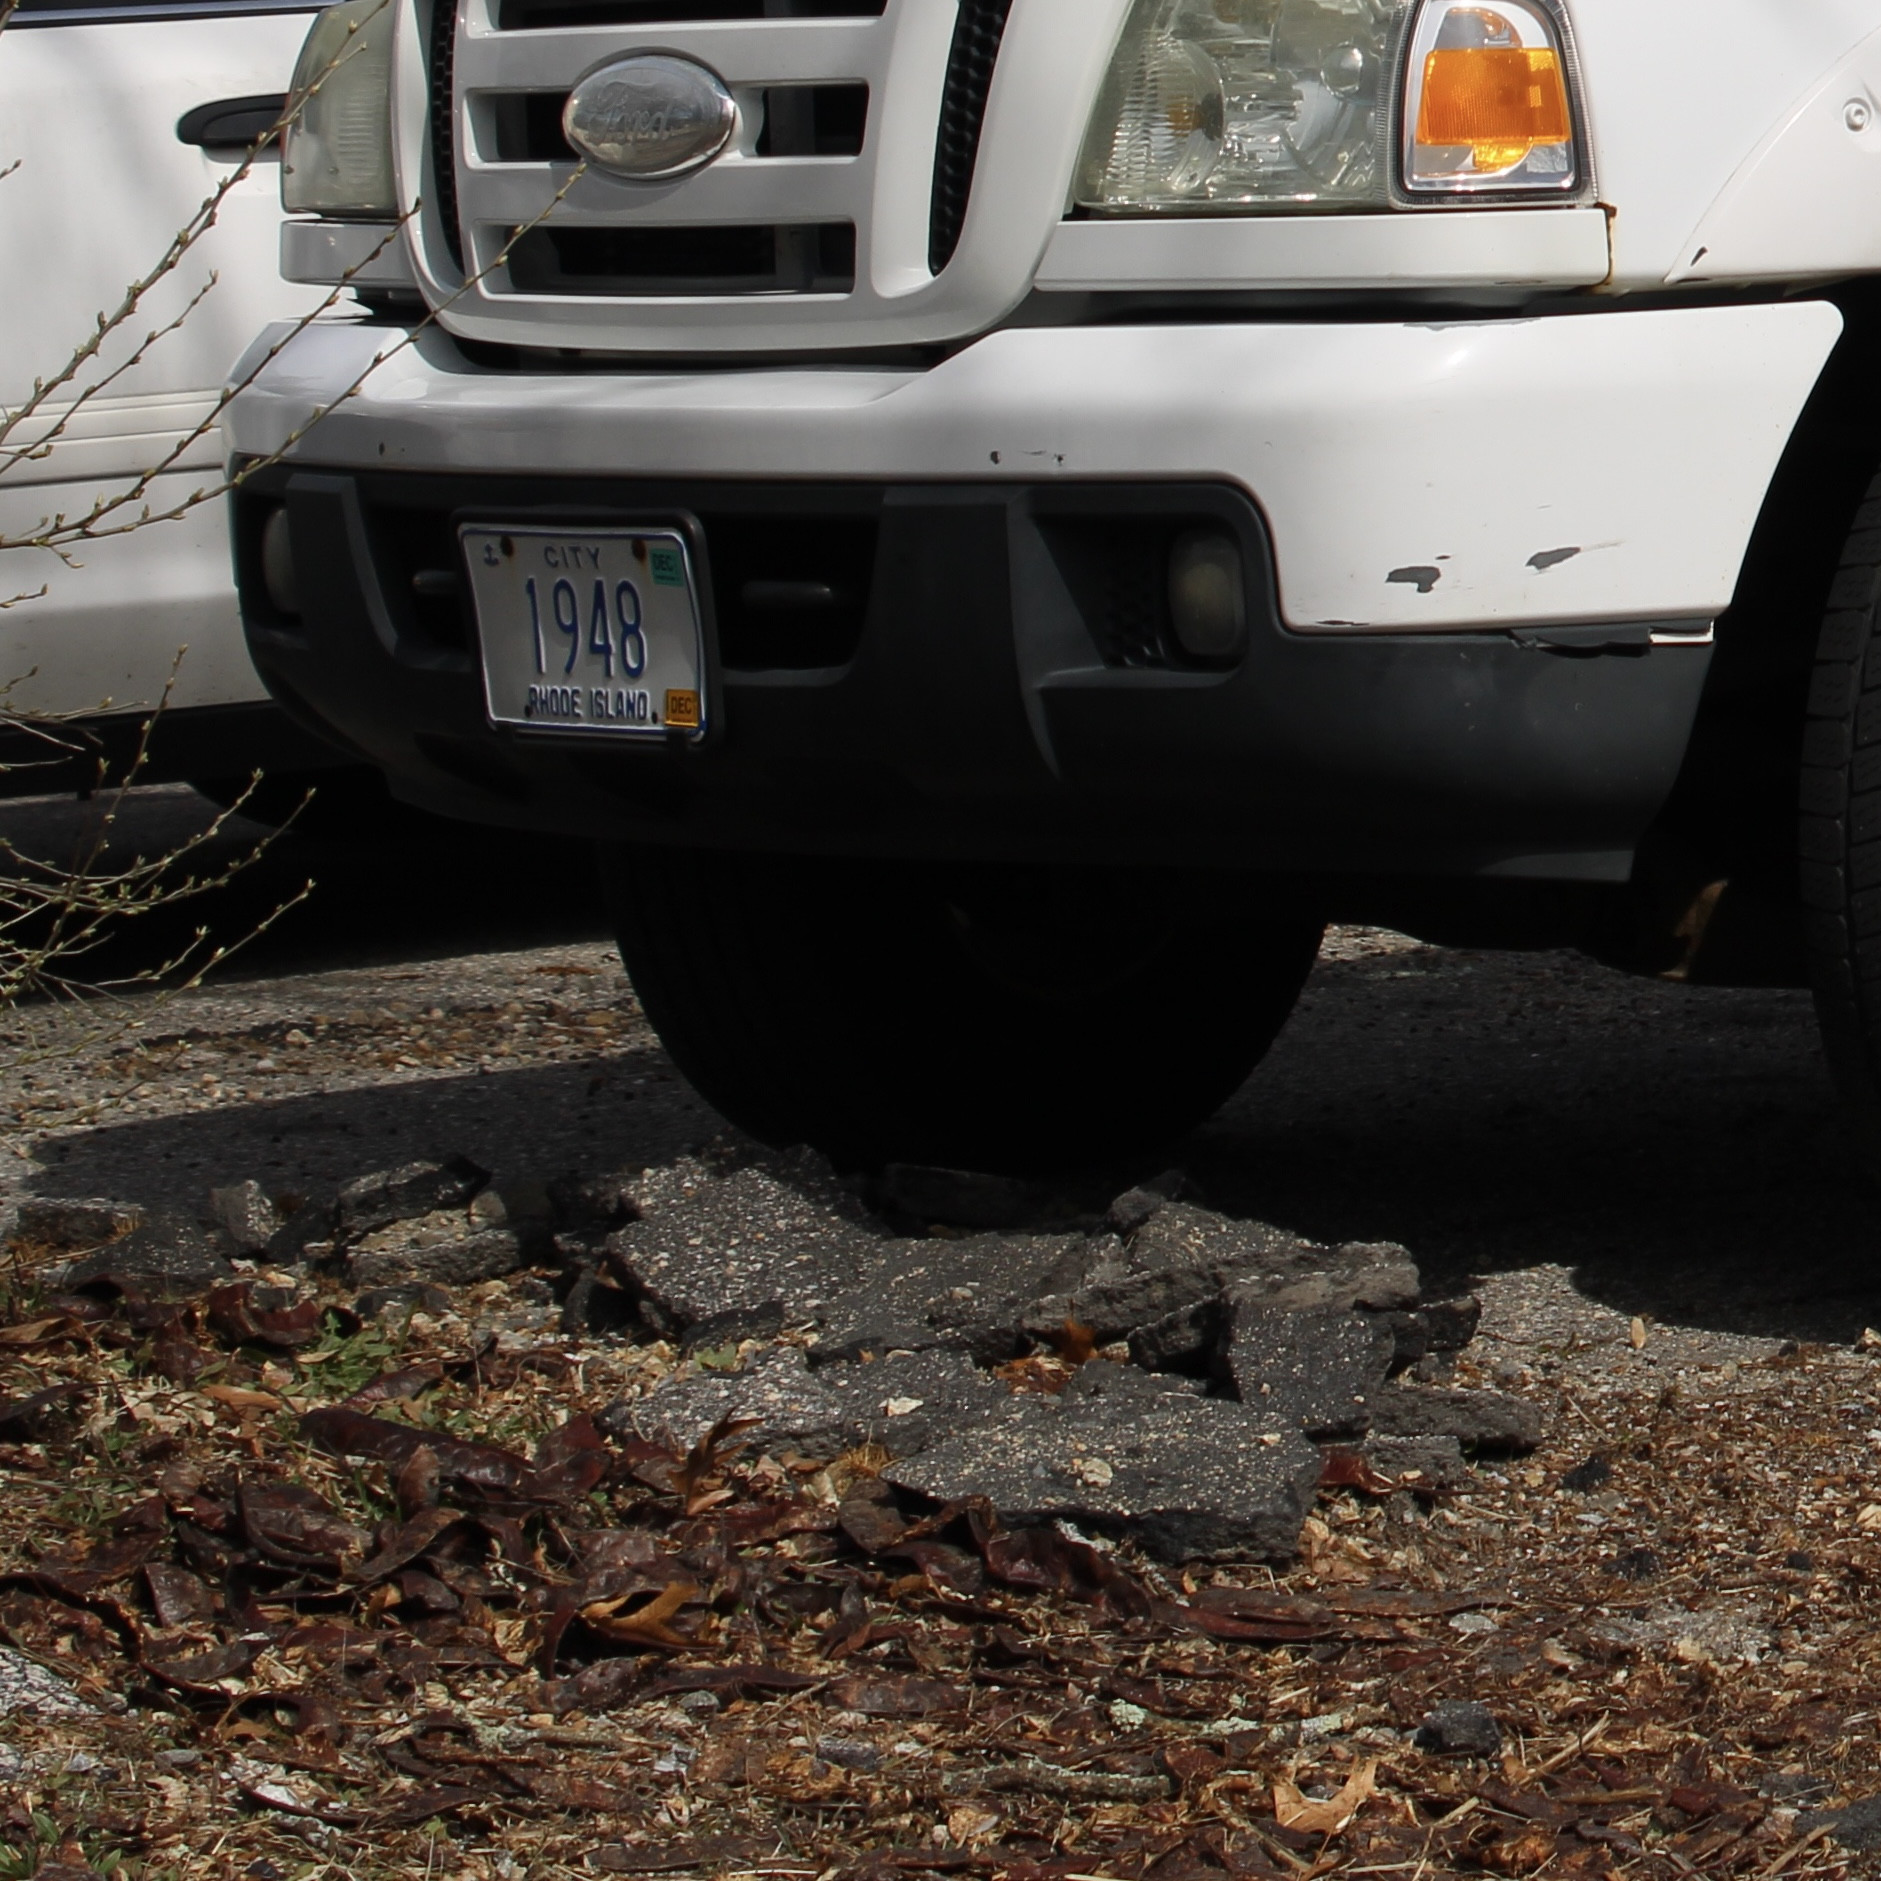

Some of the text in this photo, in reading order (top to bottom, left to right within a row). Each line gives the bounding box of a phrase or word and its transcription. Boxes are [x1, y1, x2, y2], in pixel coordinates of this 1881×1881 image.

[544, 546, 600, 569] CITY
[526, 577, 648, 678] 1948
[529, 685, 650, 720] RHODE ISLAND
[671, 696, 692, 715] DEC
